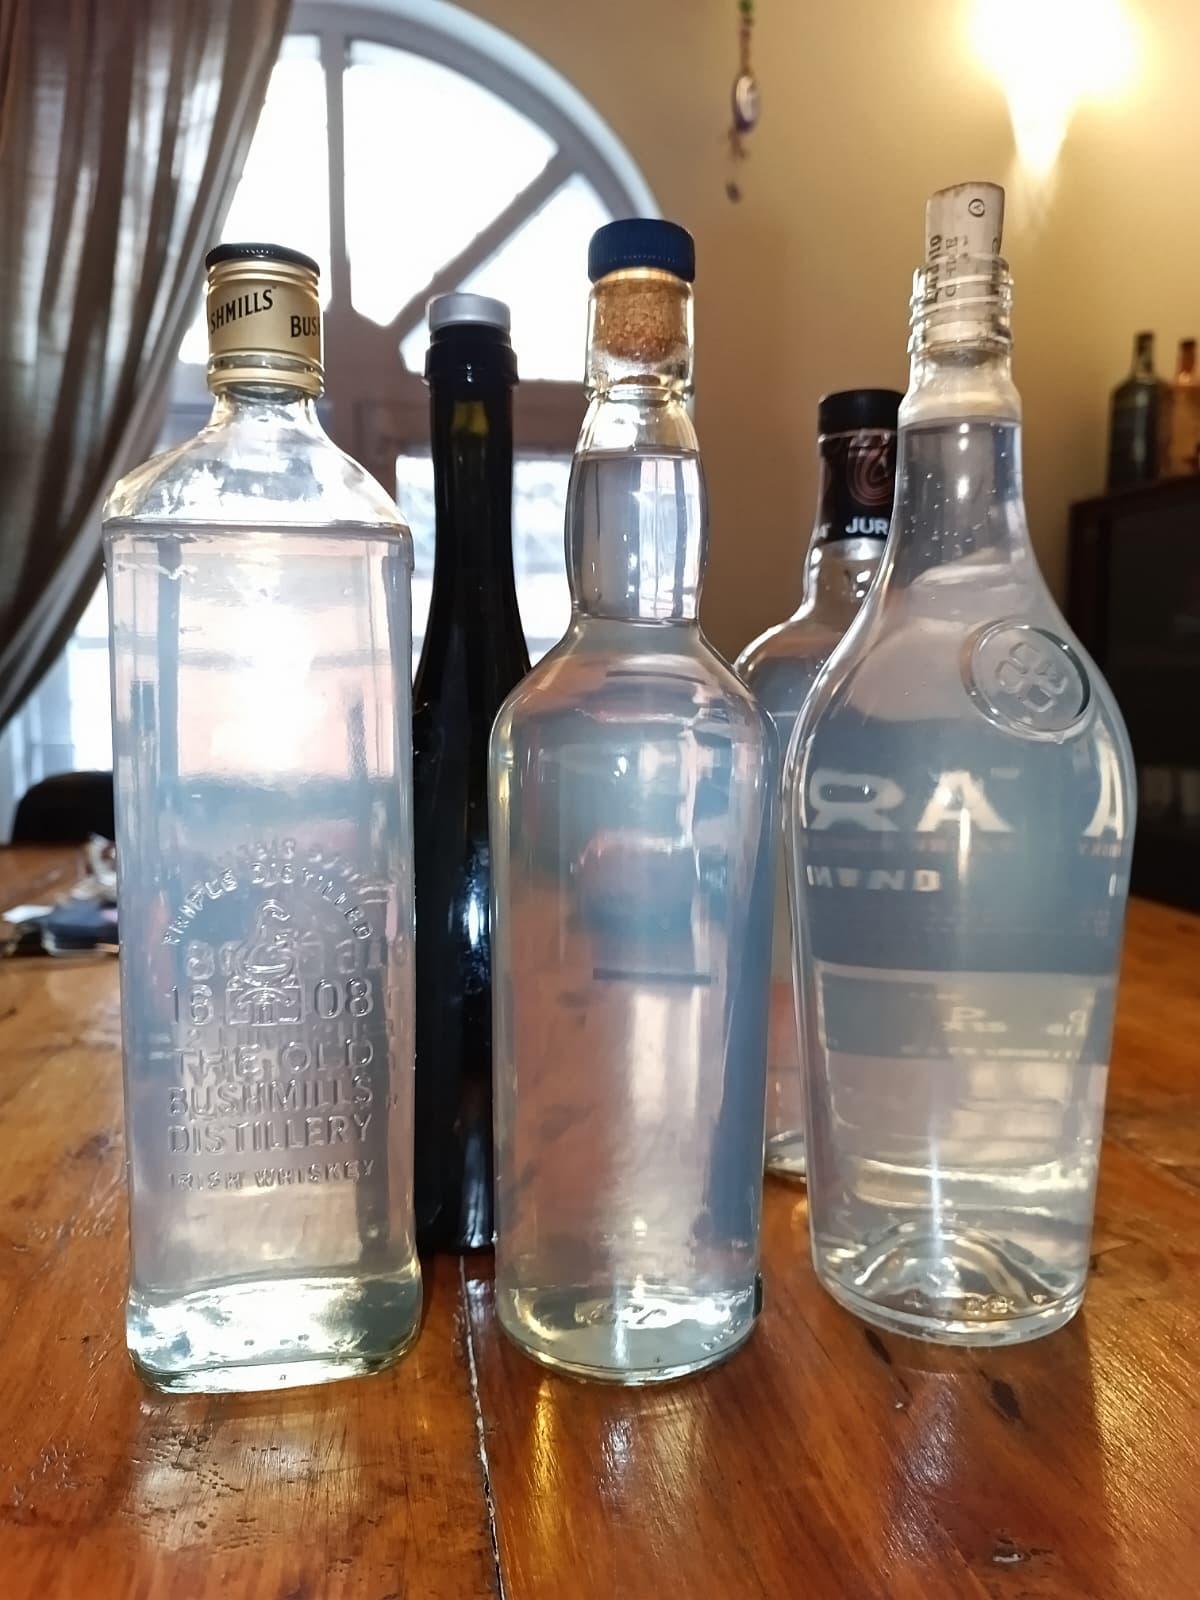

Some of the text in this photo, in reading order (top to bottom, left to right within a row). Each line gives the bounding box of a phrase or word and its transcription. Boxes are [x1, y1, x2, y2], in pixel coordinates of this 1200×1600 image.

[845, 516, 890, 535] JUR
[281, 1038, 374, 1075] OLD
[167, 1074, 374, 1115] BUSHMILLS
[167, 1112, 373, 1156] DISTILLERY
